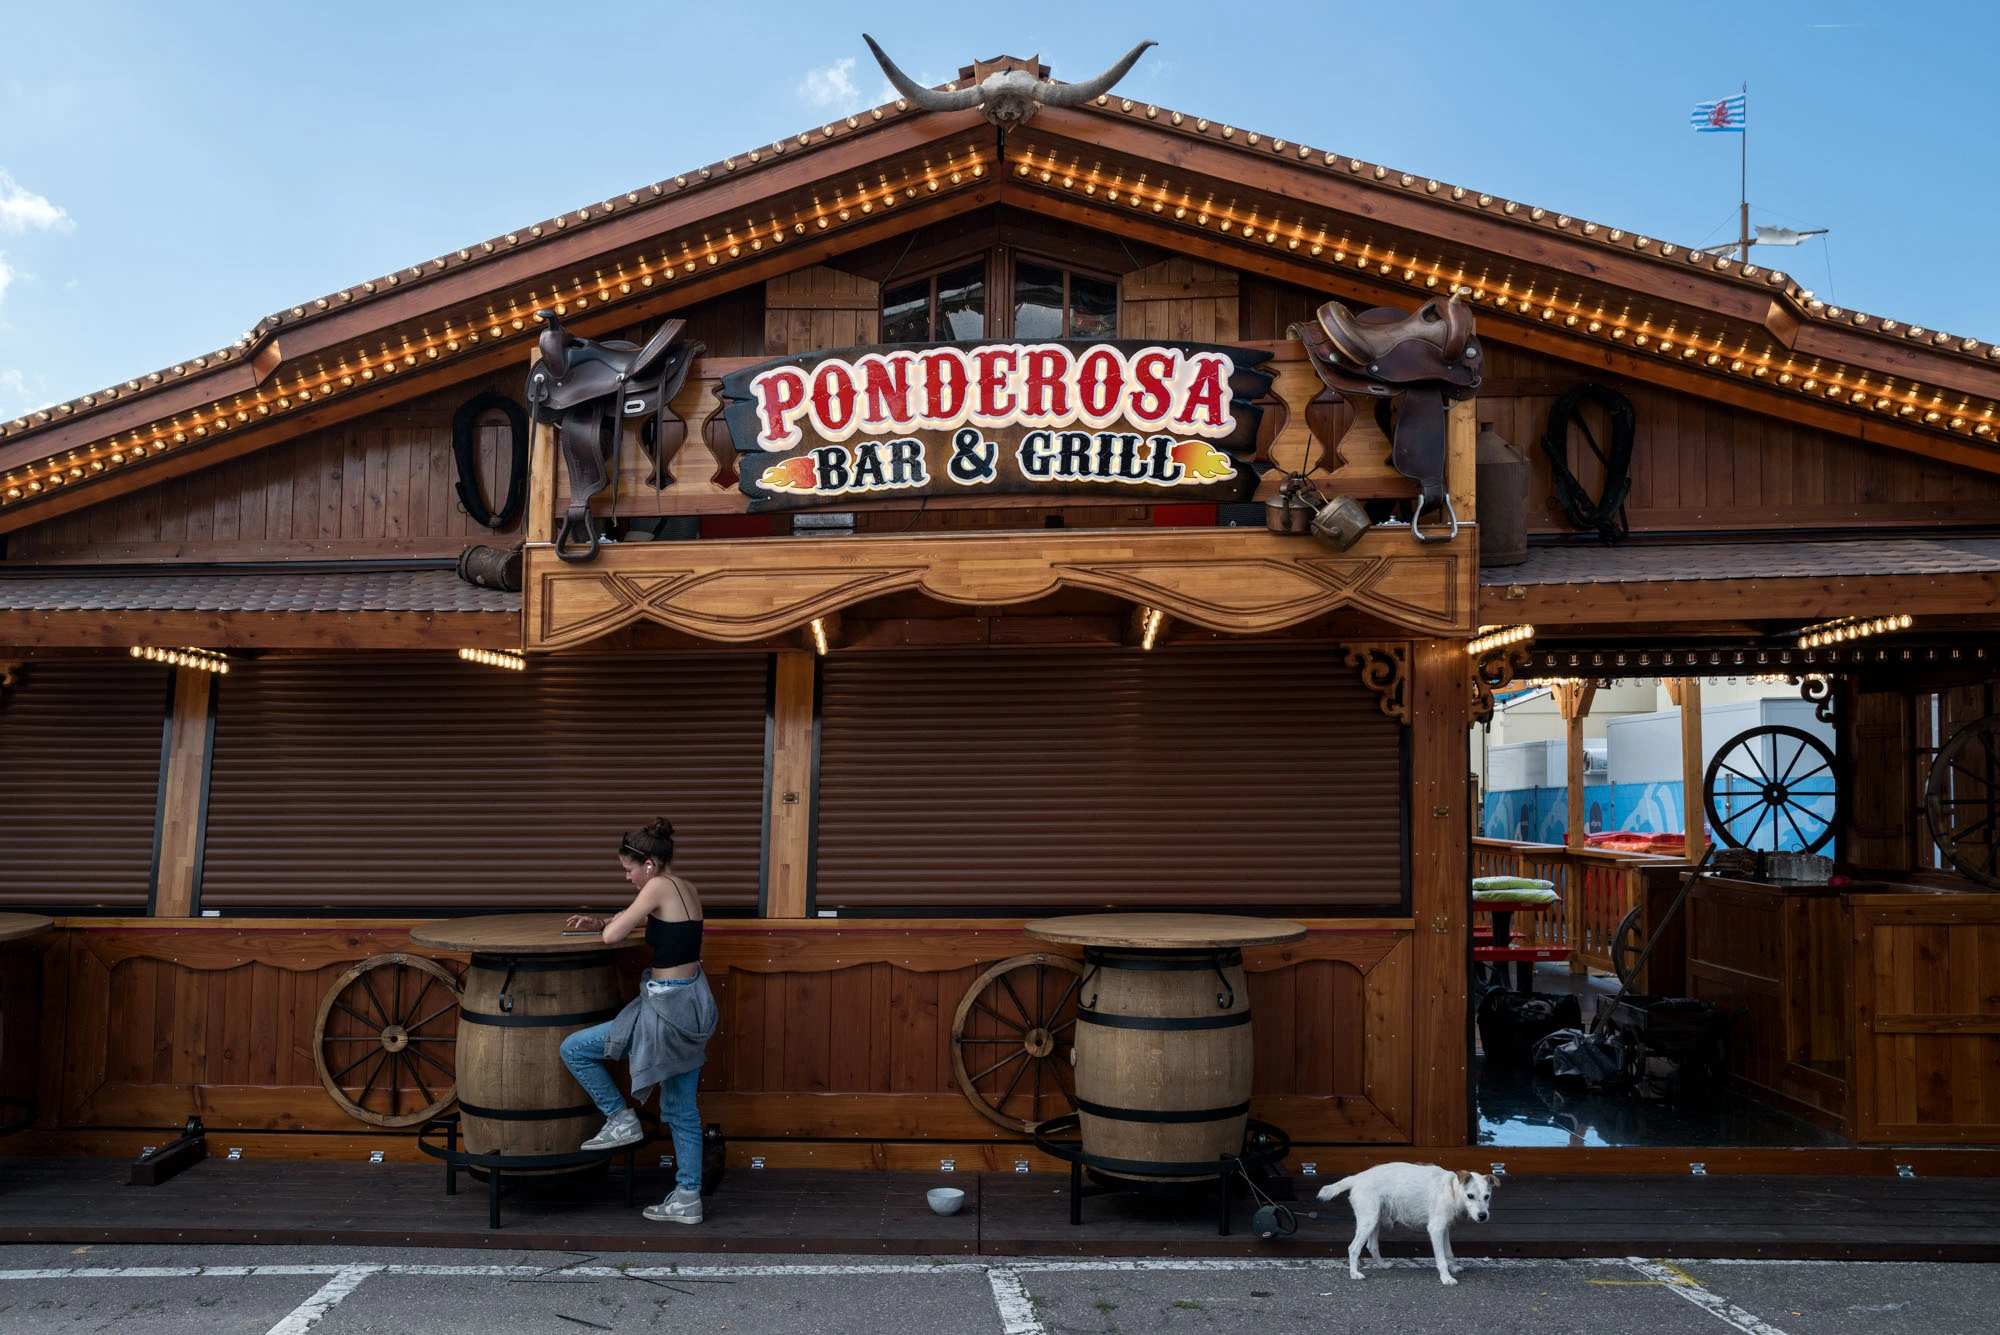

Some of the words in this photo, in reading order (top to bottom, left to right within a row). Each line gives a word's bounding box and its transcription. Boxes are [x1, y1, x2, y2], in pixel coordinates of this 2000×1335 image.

[756, 348, 1231, 442] PONDEROSA
[815, 440, 928, 490] BAR
[949, 429, 996, 479] &
[1019, 432, 1182, 482] GRILL
